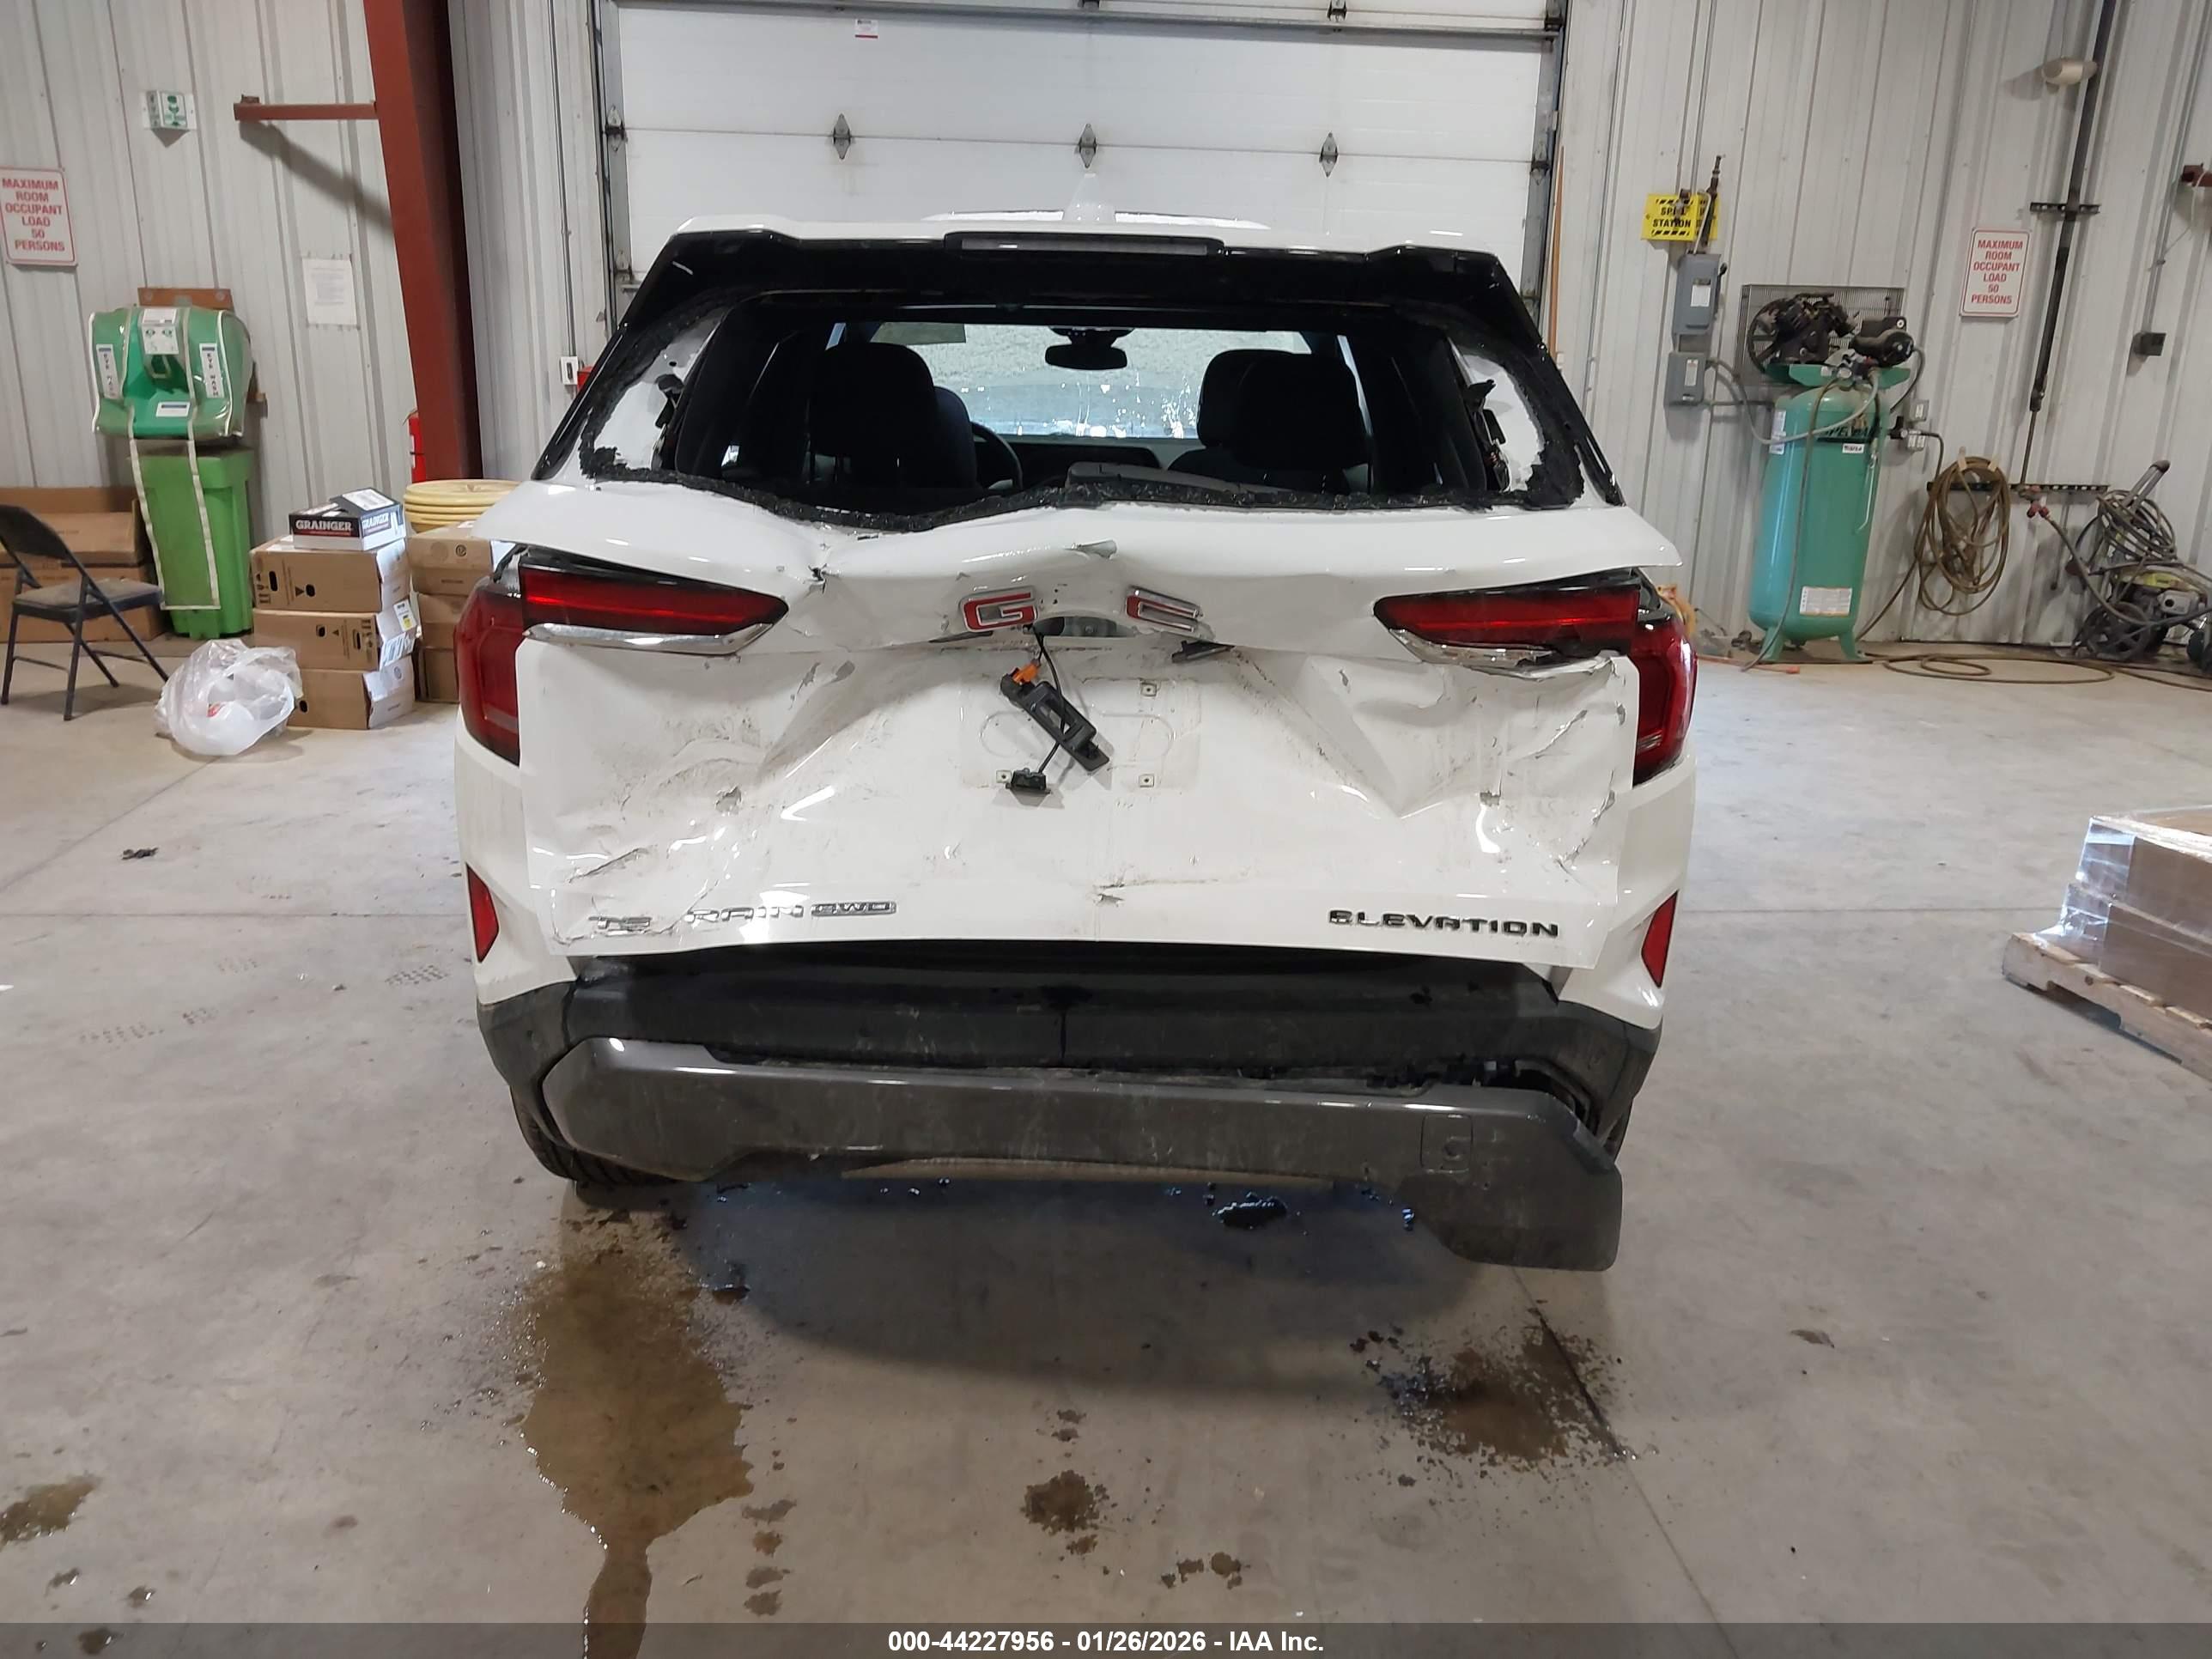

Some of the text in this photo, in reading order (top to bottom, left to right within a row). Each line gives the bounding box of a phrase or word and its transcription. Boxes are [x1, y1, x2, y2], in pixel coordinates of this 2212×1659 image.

[2, 178, 59, 190] MAXIMUM
[15, 191, 49, 202] ROOM
[5, 203, 62, 215] OCCUPANT
[1661, 206, 1686, 216] SPIL
[21, 216, 51, 227] LOAD
[31, 228, 45, 239] 50
[15, 240, 65, 252] PERSONS
[1977, 240, 2023, 250] MAXIMUM
[1984, 250, 2012, 260] ROOM
[1972, 261, 2021, 271] OCCUPANT
[1983, 273, 2007, 283] LOAD
[1987, 283, 1999, 293] 50
[1971, 294, 2012, 304] PERSONS
[295, 519, 352, 532] GRAINGER
[1329, 910, 1559, 937] ELEVATION
